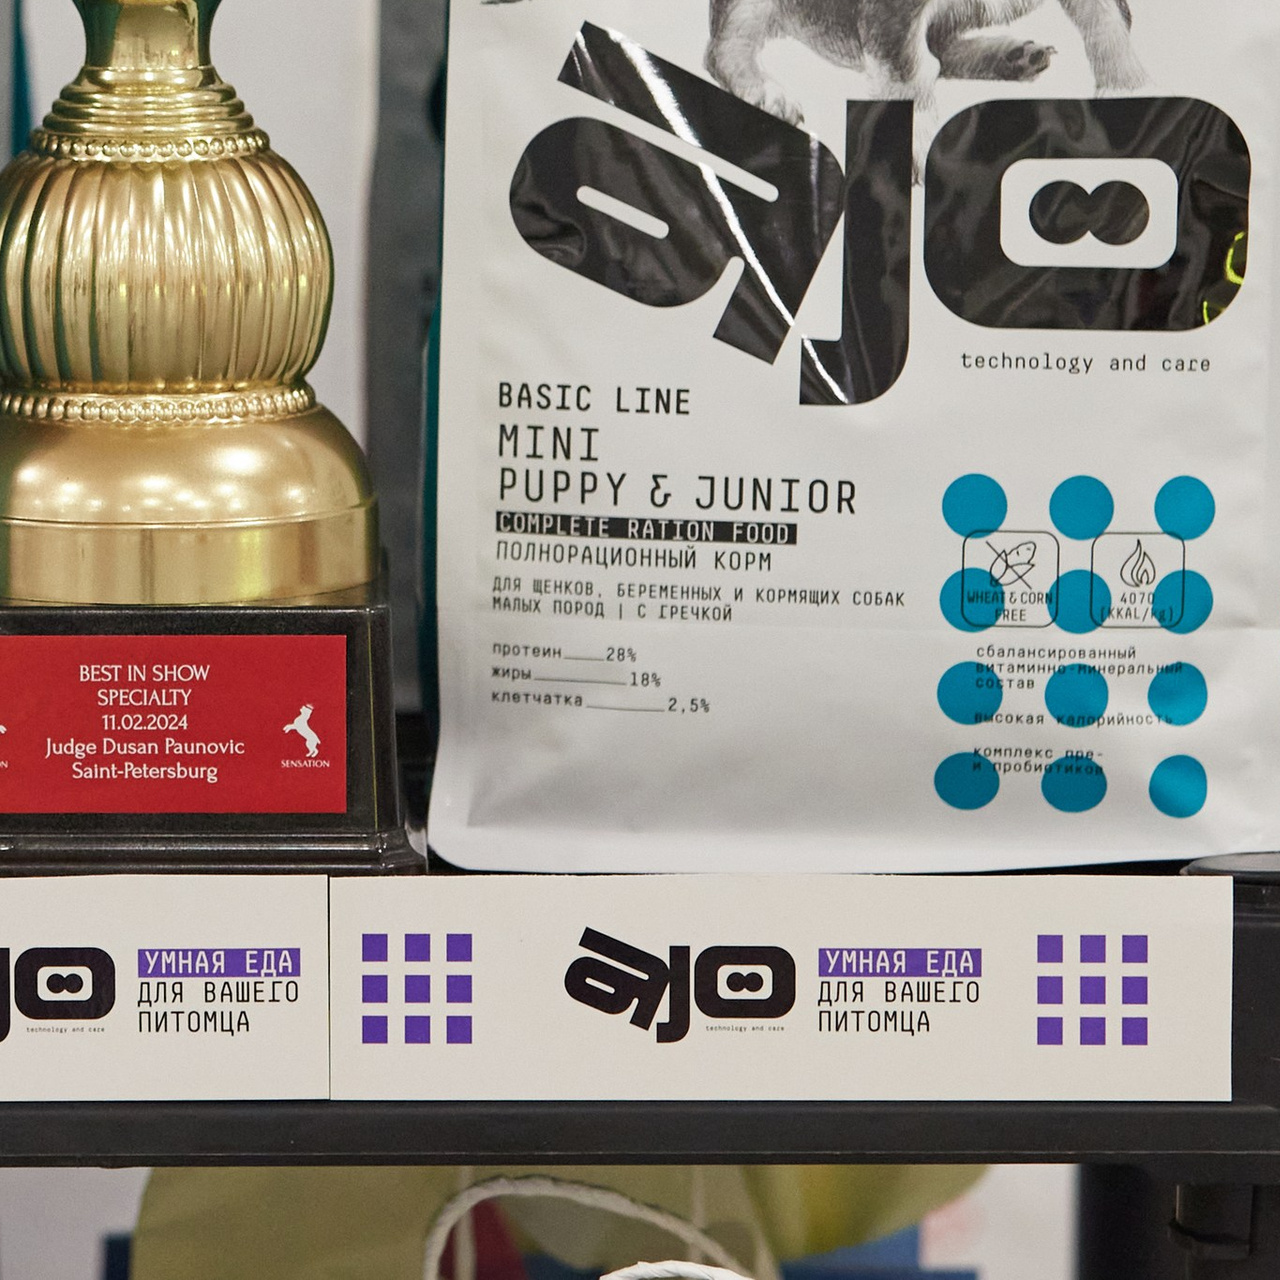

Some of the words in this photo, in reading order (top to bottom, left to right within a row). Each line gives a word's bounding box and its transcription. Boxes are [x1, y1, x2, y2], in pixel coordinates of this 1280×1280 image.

[960, 352, 1094, 375] technology
[1109, 354, 1146, 372] and
[1161, 356, 1210, 373] care
[498, 383, 592, 412] BASIC
[615, 387, 691, 415] LINE
[498, 425, 600, 462] MINI
[499, 468, 627, 506] PUPPY
[649, 474, 672, 508] &
[695, 475, 857, 514] JUNIOR
[498, 512, 610, 538] COMPLETE
[628, 519, 714, 542] RATION
[732, 523, 788, 544] FOOD
[496, 540, 697, 571] ПОЛНОРАЦИОННЫЙ
[714, 551, 772, 571] КОРМ
[492, 576, 521, 594] ДЛЯ
[532, 580, 602, 598] ЩЕНКОВ,
[617, 583, 722, 601] БЕРЕМЕННЫХ
[733, 587, 743, 602] И
[755, 588, 840, 606] КОРМЯЩИХ
[852, 590, 905, 606] СОБАК
[1020, 592, 1053, 605] CORN
[1120, 593, 1155, 605] 4070
[492, 596, 541, 615] МАЛЫХ
[552, 599, 605, 619] ПОРОД
[637, 603, 647, 619] С
[659, 602, 733, 622] ГРЕЧКОЙ
[995, 609, 1026, 621] FREE
[492, 641, 562, 663] протеин
[606, 647, 637, 664] 28%
[977, 645, 1136, 659] сбалансированный
[79, 665, 123, 682] BEST
[127, 665, 147, 682] IN
[151, 664, 210, 682] SHOW
[491, 667, 532, 683] жиры
[630, 671, 661, 688] 18%
[976, 677, 1035, 689] состав
[97, 689, 193, 707] SPECIALTY
[491, 690, 583, 708] клетчатка
[668, 698, 710, 715] 2,5%
[102, 715, 189, 731] 11.02.2024
[974, 713, 1045, 724] высокая
[1057, 713, 1173, 728] калорийность
[45, 739, 97, 759] Judge
[102, 739, 159, 755] Dusan
[164, 739, 245, 755] Paunovic
[973, 747, 1053, 759] комплекс
[71, 762, 218, 783] Saint-Petersburg
[281, 759, 330, 768] SENSATION
[973, 762, 982, 771] и
[993, 760, 1103, 775] пробиотиков
[146, 950, 225, 976] УМНАЯ
[245, 950, 294, 978] ЕДА
[825, 949, 906, 975] УМНАЯ
[925, 950, 975, 978] ЕДА
[137, 980, 185, 1007] ДЛЯ
[204, 980, 299, 1004] ВАШЕГО
[817, 980, 865, 1006] ДЛЯ
[884, 980, 981, 1004] ВАШЕГО
[138, 1010, 251, 1037] ПИТОМЦА
[818, 1009, 931, 1036] ПИТОМЦА
